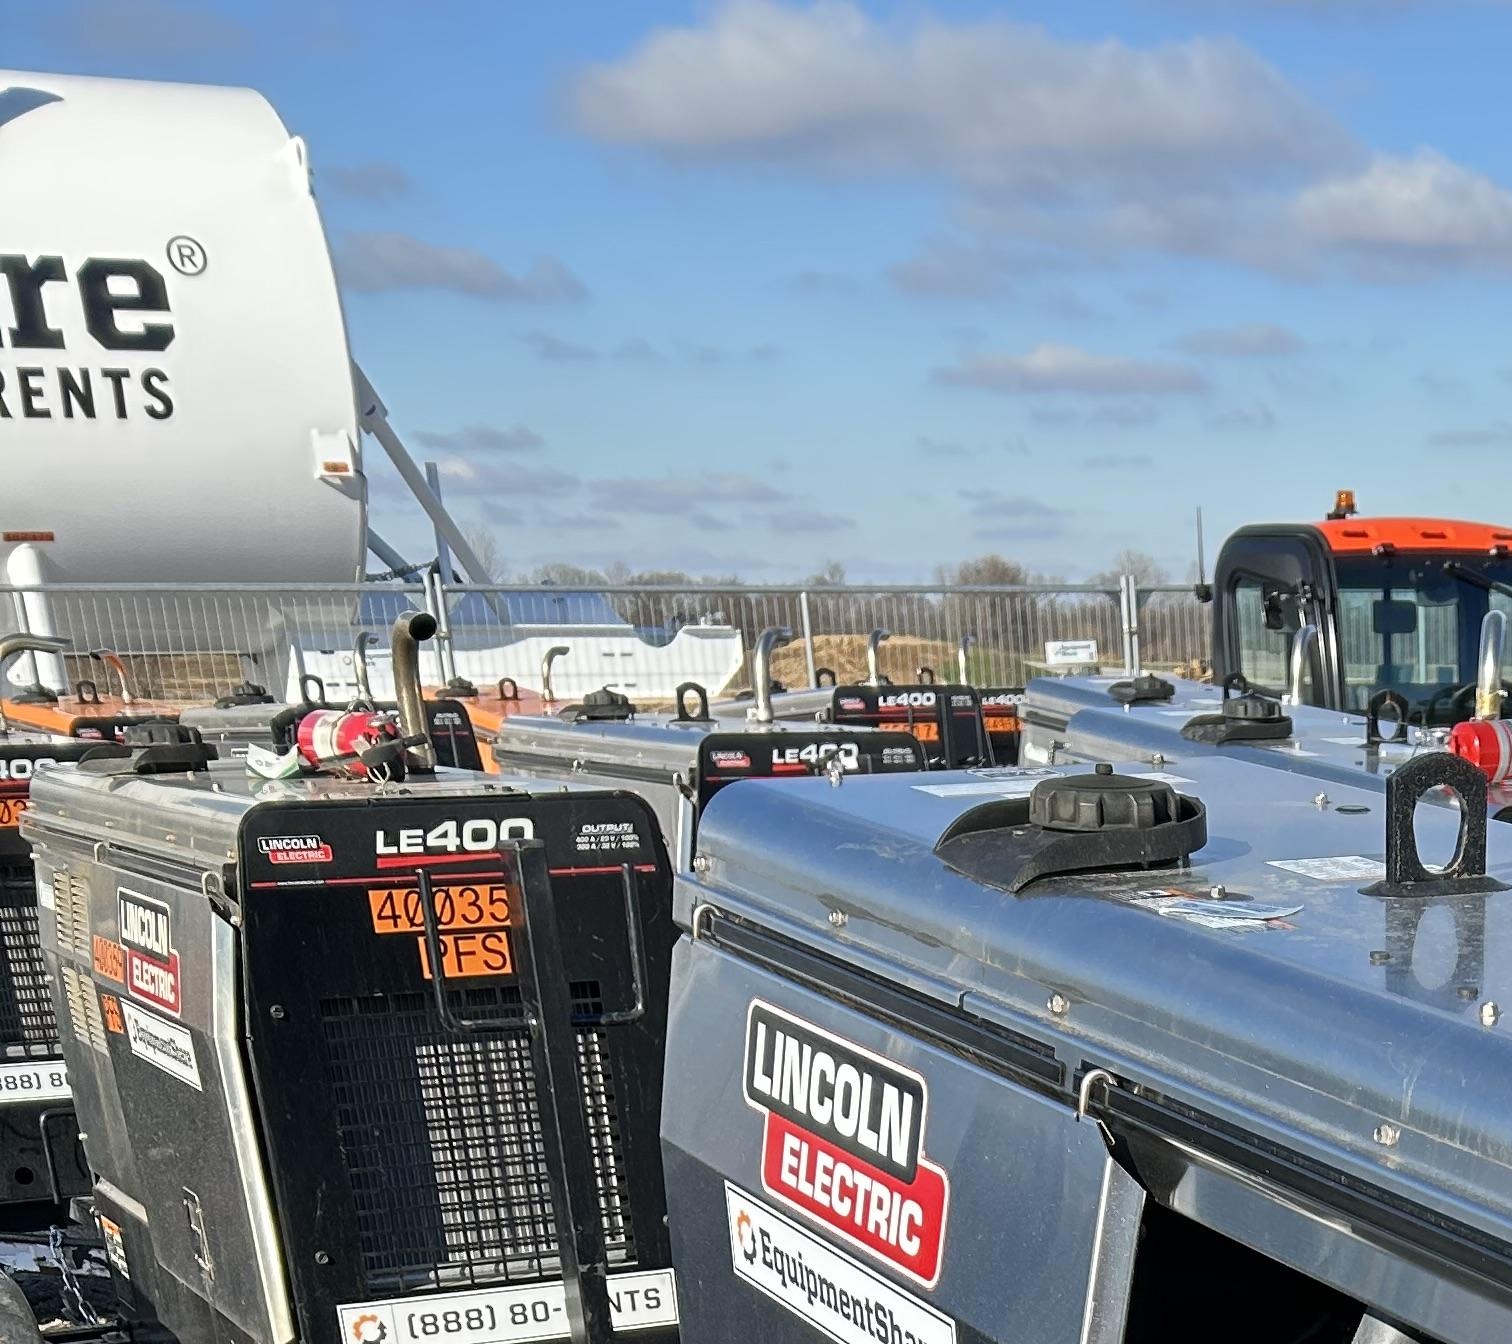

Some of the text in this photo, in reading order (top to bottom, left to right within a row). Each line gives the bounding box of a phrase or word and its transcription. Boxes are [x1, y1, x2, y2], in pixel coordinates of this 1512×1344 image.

[260, 836, 319, 851] LINCOLN
[375, 817, 535, 855] LE400
[276, 849, 327, 862] ELECTRIC
[120, 899, 169, 958] LINCOLN
[132, 957, 176, 1005] ELECTRIC
[0, 1072, 41, 1090] 88)
[753, 1021, 914, 1168] LINCOLN
[780, 1130, 923, 1257] ELECTRIC
[407, 1305, 497, 1339] (888)
